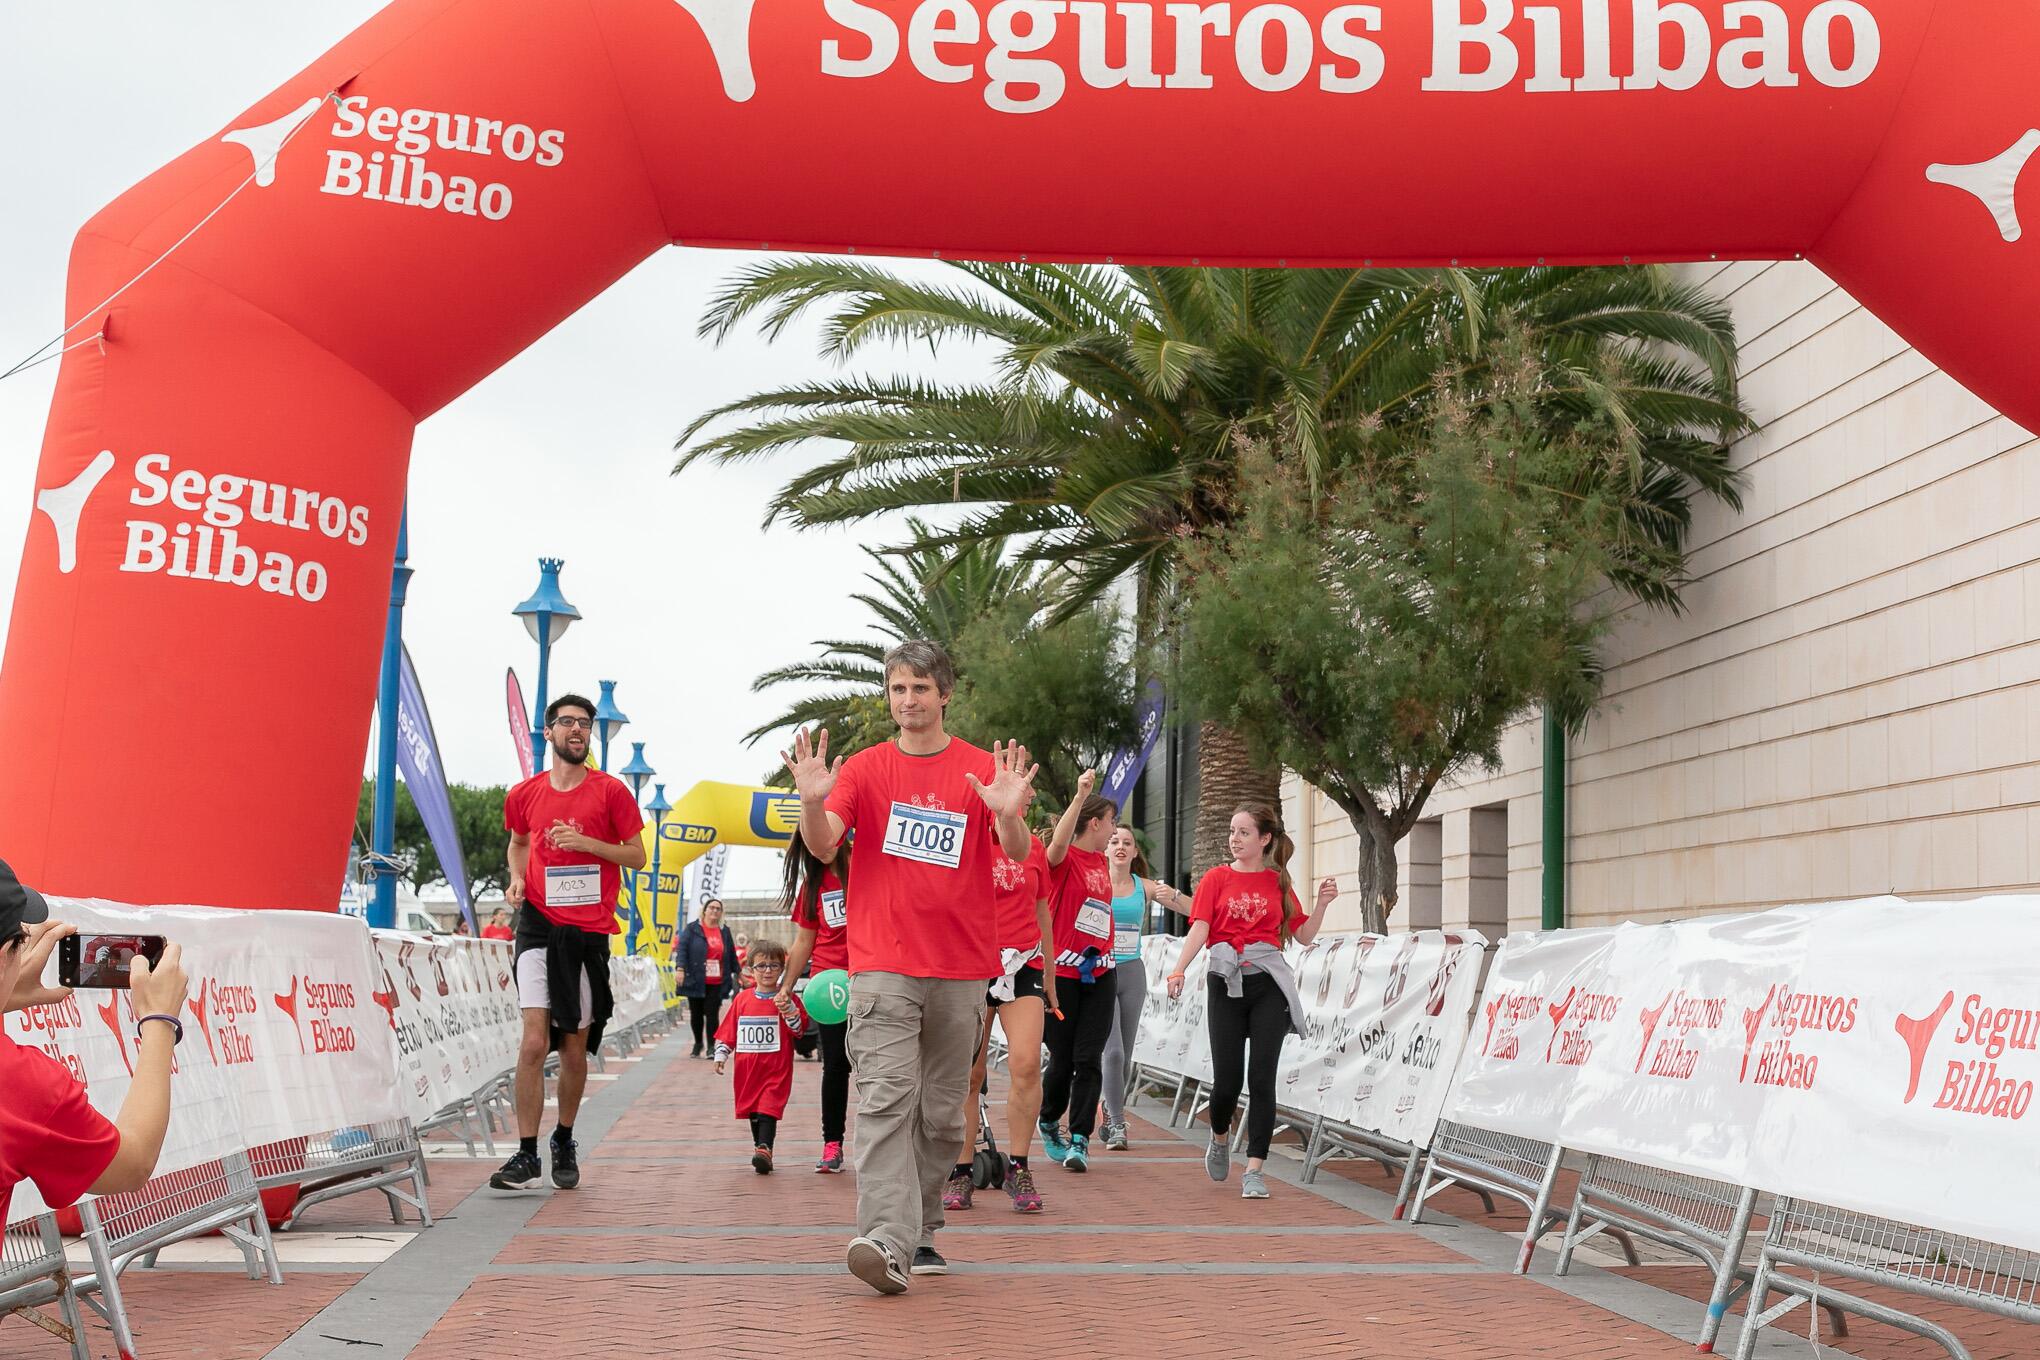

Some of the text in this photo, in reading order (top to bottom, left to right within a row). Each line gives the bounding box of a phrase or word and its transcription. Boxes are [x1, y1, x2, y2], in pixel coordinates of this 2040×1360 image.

[820, 0, 1881, 113] Seguros Bilbao
[331, 95, 565, 166] Seguros
[319, 149, 513, 220] Bilbao
[129, 453, 369, 546] Seguros
[119, 520, 328, 602] Bilbao
[684, 826, 714, 843] BM
[897, 819, 956, 853] 1008
[556, 879, 586, 892] 1023
[303, 975, 355, 1017] Seguros
[1666, 989, 1727, 1037] Seguros
[1770, 983, 1859, 1038] Seguros
[310, 1019, 355, 1054] Bilbao
[740, 1026, 775, 1044] 1008
[1402, 1022, 1442, 1071] Getxo
[1555, 1030, 1593, 1067] Bilbao
[1648, 1037, 1699, 1080] Bilbao
[1753, 1039, 1819, 1091] Bilbao
[1932, 1060, 2034, 1120] Bilbao
